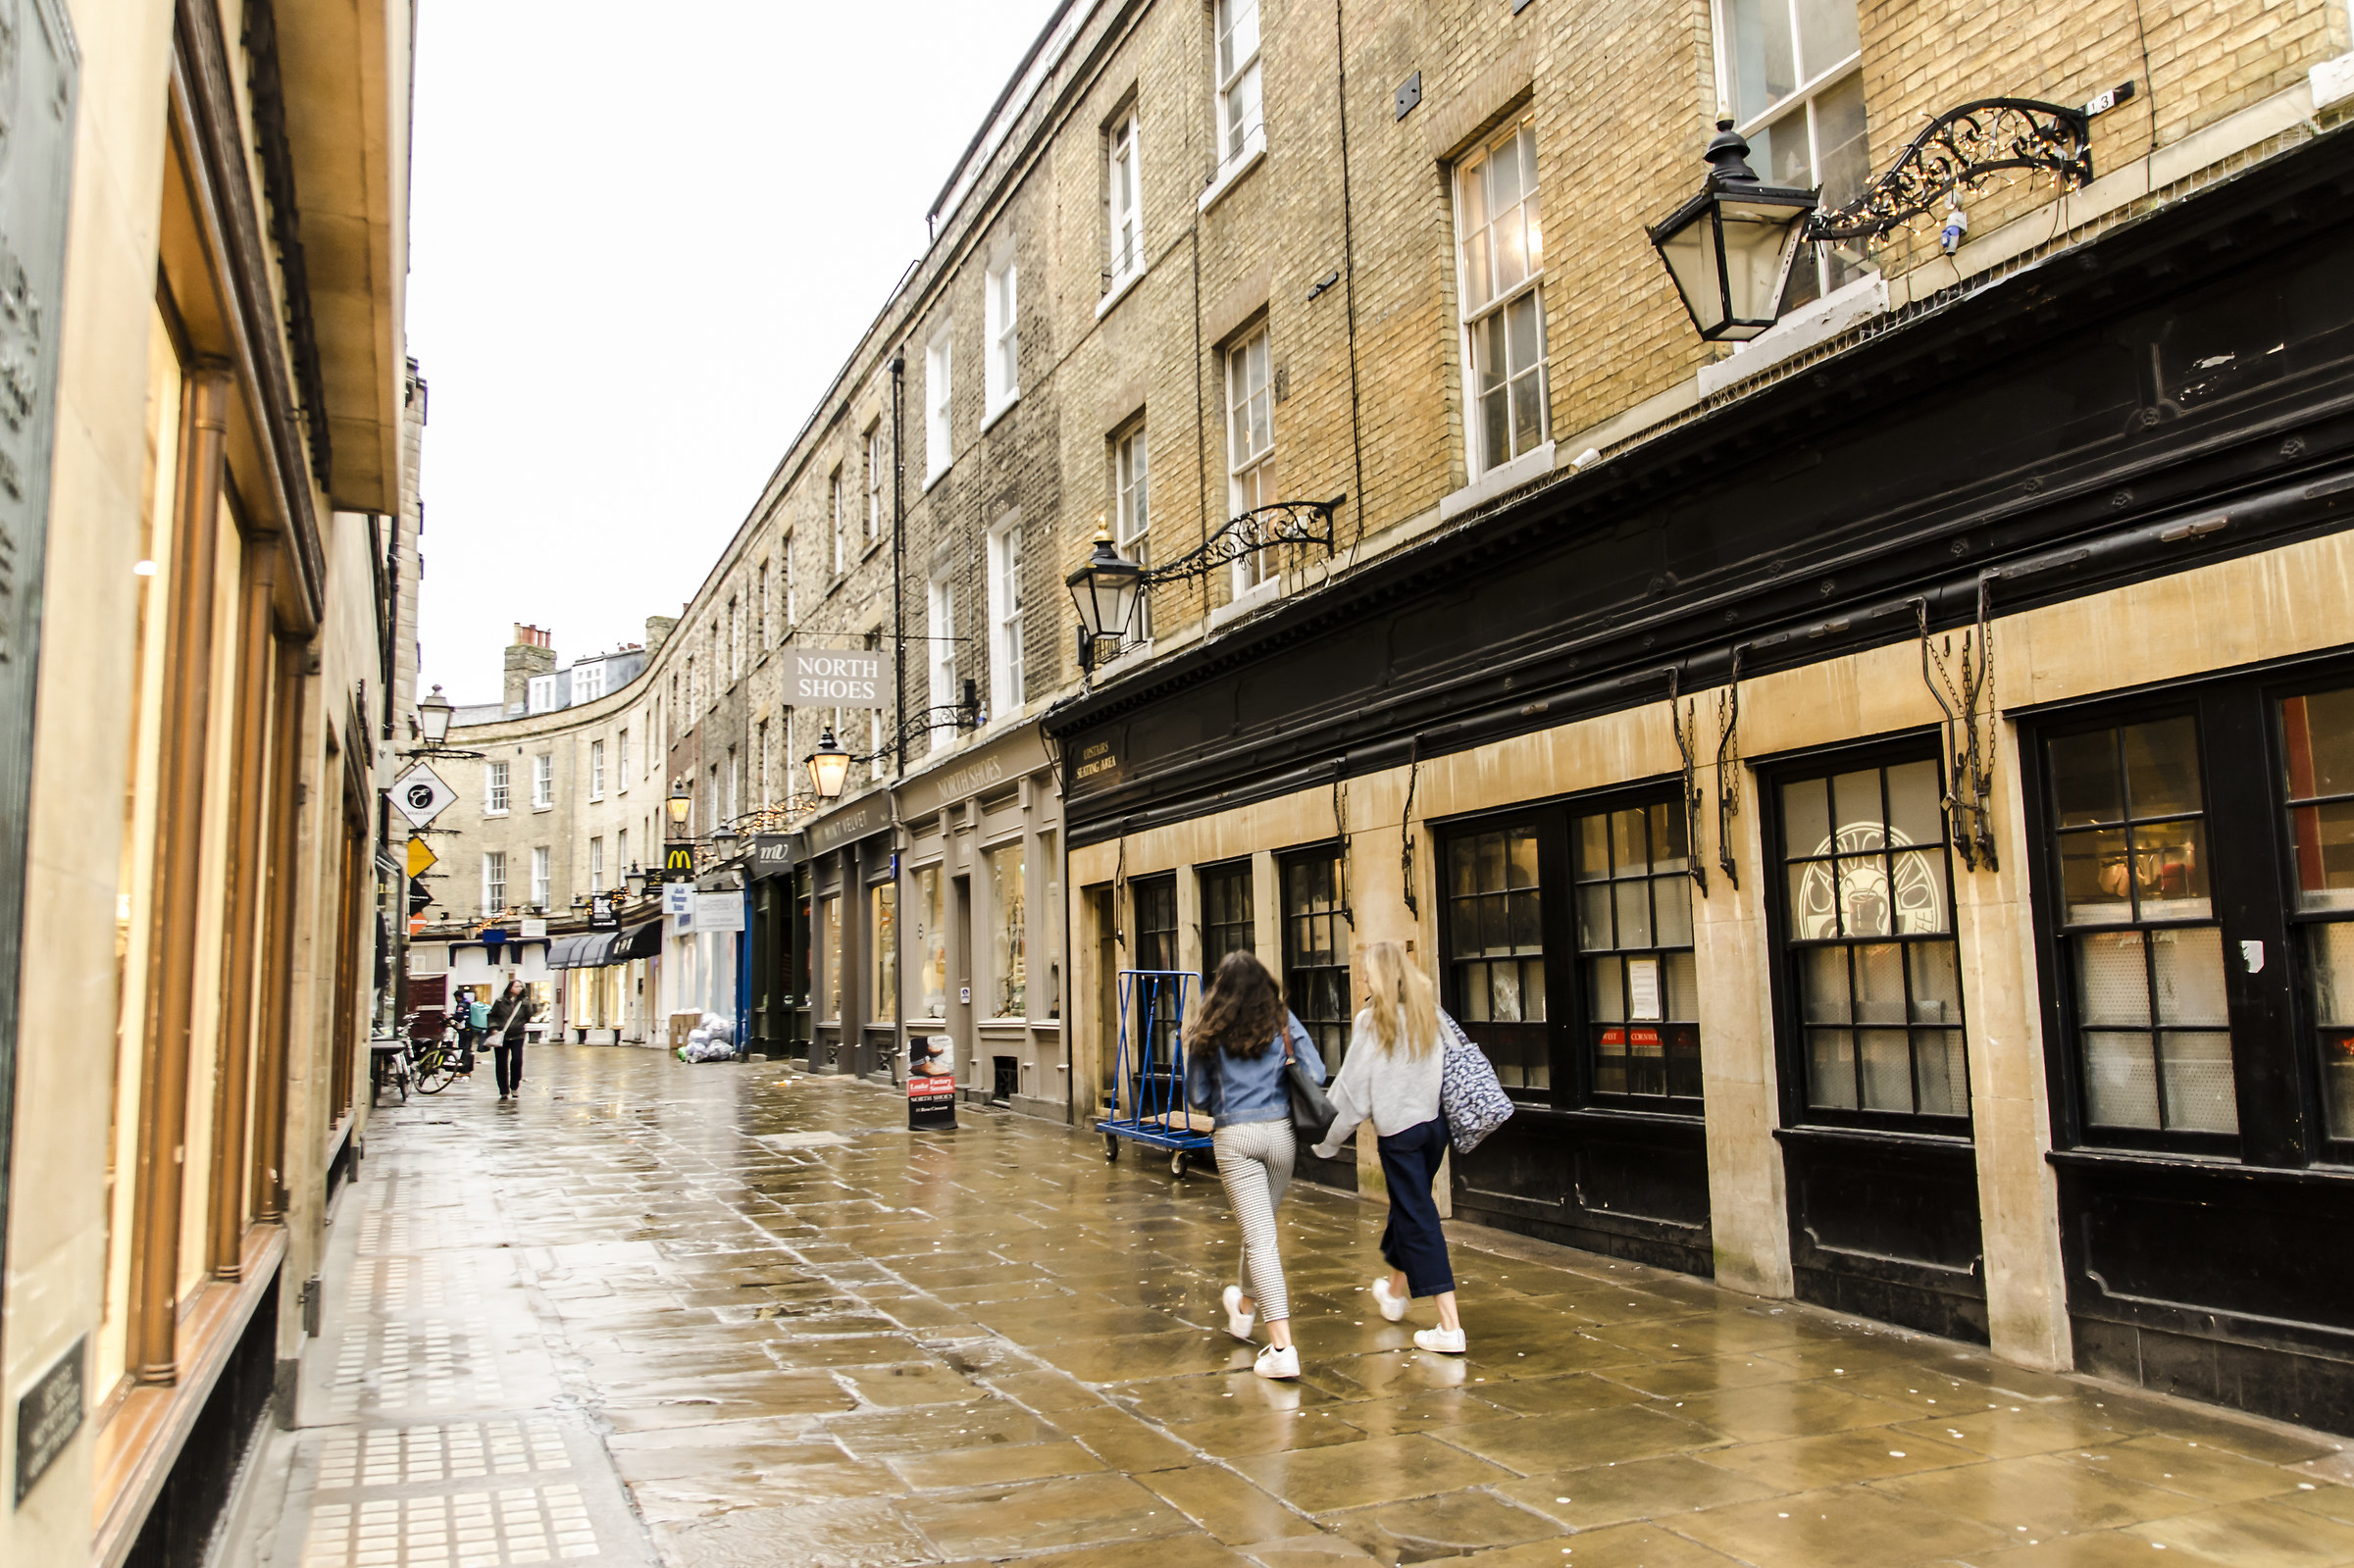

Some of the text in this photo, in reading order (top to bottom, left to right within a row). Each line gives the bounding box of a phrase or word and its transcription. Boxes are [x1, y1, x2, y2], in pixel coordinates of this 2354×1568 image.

[795, 657, 879, 679] NORTH
[798, 679, 876, 699] SHOES
[1100, 755, 1117, 772] AREA
[937, 754, 1002, 801] NORTH SHOES
[842, 810, 867, 834] VELVET
[1630, 1033, 1659, 1041] CORNWA
